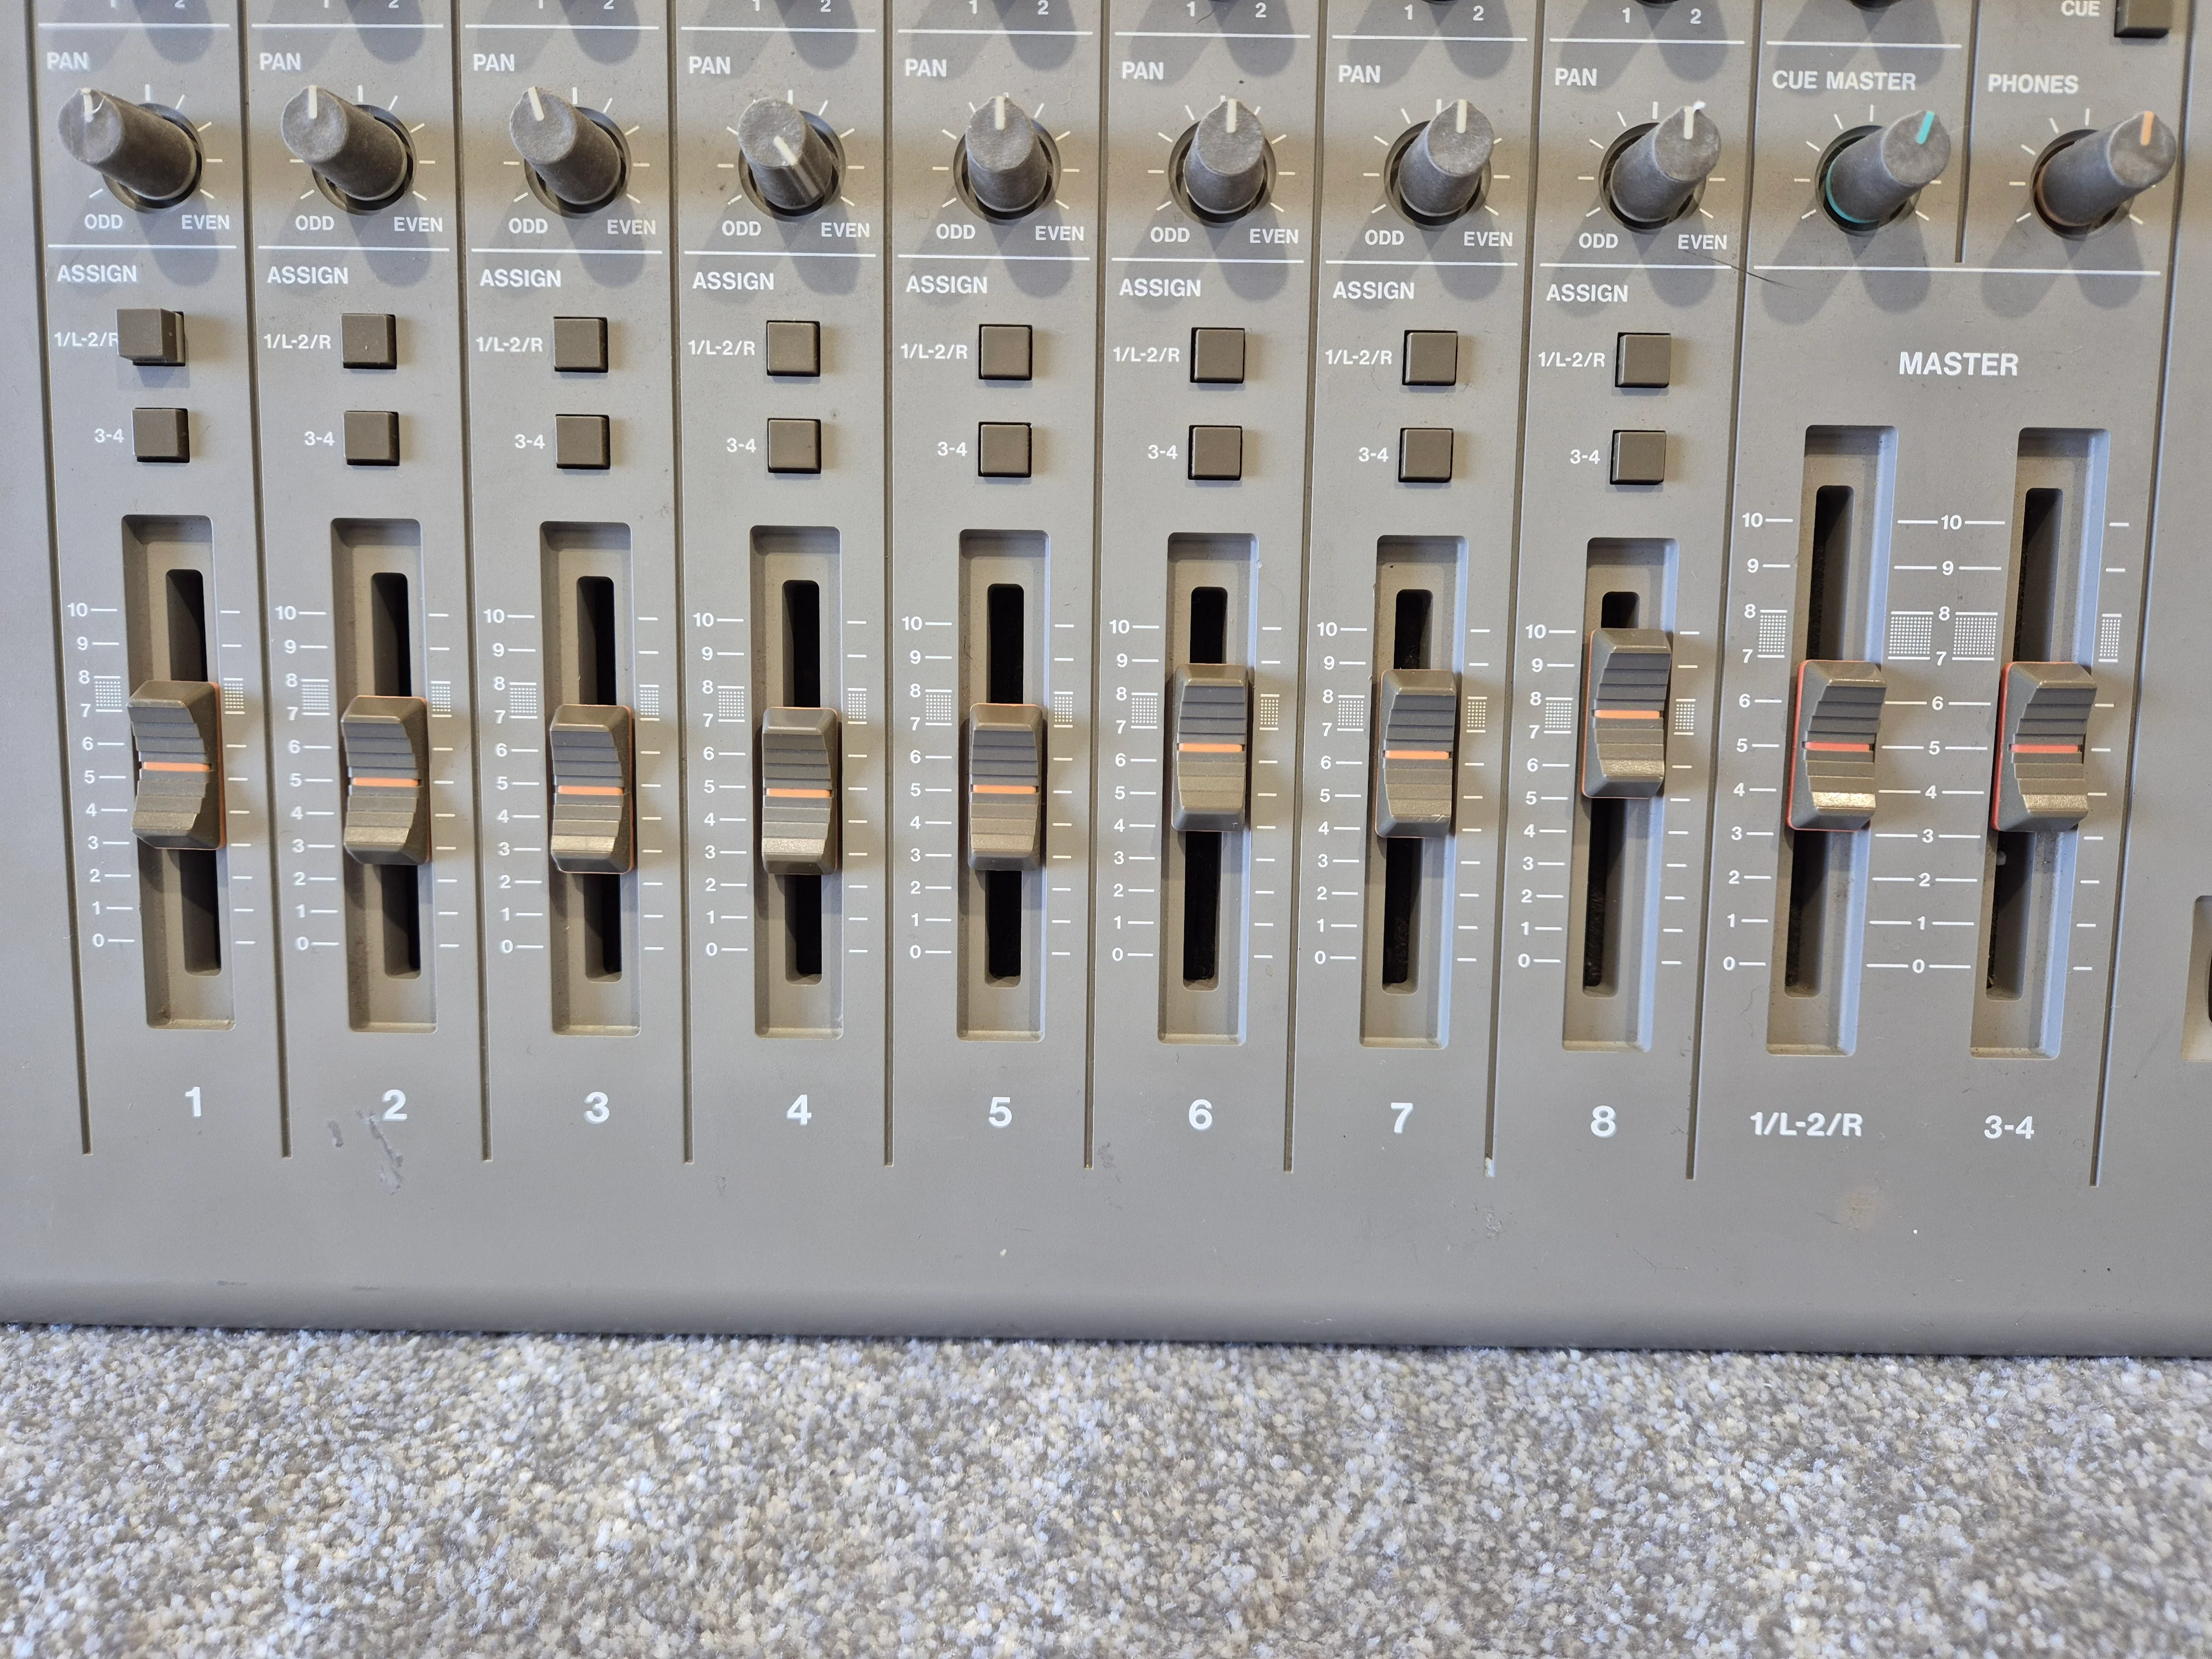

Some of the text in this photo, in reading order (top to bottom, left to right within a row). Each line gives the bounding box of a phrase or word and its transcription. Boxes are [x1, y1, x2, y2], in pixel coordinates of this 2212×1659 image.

[752, 0, 760, 12] 1
[820, 0, 832, 13] 2
[968, 0, 978, 14] 1
[1037, 0, 1049, 15] 2
[1186, 1, 1196, 17] 1
[1255, 2, 1267, 18] 2
[1404, 4, 1413, 20] 1
[1473, 5, 1484, 21] 2
[2060, 0, 2101, 17] CUE
[1622, 7, 1630, 23] 1
[1690, 8, 1702, 24] 2
[46, 51, 88, 70] PAN
[259, 52, 301, 71] PAN
[473, 53, 515, 72] PAN
[688, 56, 731, 75] PAN
[905, 58, 947, 77] PAN
[1122, 61, 1164, 80] PAN
[1338, 65, 1381, 84] PAN
[1554, 67, 1598, 86] PAN
[1772, 70, 1916, 91] CUE MASTER
[1988, 74, 2079, 94] PHONES
[84, 213, 123, 229] ODD
[181, 214, 230, 230] EVEN
[295, 215, 335, 231] ODD
[394, 216, 443, 232] EVEN
[508, 217, 549, 234] ODD
[607, 219, 656, 235] EVEN
[722, 220, 761, 236] ODD
[821, 222, 870, 238] EVEN
[936, 223, 976, 239] ODD
[1035, 225, 1084, 241] EVEN
[1150, 226, 1191, 243] ODD
[1249, 228, 1299, 244] EVEN
[1364, 229, 1405, 246] ODD
[1464, 231, 1513, 247] EVEN
[1578, 232, 1619, 249] ODD
[1678, 234, 1728, 251] EVEN
[56, 264, 137, 283] ASSIGN
[267, 265, 348, 285] ASSIGN
[479, 268, 561, 288] ASSIGN
[692, 271, 774, 291] ASSIGN
[905, 275, 988, 294] ASSIGN
[1119, 278, 1201, 297] ASSIGN
[1332, 280, 1415, 300] ASSIGN
[1546, 283, 1629, 302] ASSIGN
[263, 333, 331, 349] 1/L-2/R
[476, 336, 543, 352] 1/L-2/R
[688, 340, 755, 356] 1/L-2/R
[900, 343, 968, 359] 1/L-2/R
[1113, 346, 1180, 362] 1/L-2/R
[1324, 349, 1392, 365] 1/L-2/R
[1538, 351, 1605, 368] 1/L-2/R
[1899, 351, 2019, 376] MASTER
[95, 428, 124, 443] 3-4
[304, 431, 336, 446] 3-4
[514, 434, 546, 449] 3-4
[726, 437, 757, 453] 3-4
[937, 441, 968, 457] 3-4
[1147, 444, 1178, 460] 3-4
[1358, 447, 1389, 462] 3-4
[1569, 448, 1601, 465] 3-4
[1741, 512, 1764, 528] 10
[1940, 514, 1962, 530] 10
[1747, 558, 1759, 573] 9
[1942, 560, 1954, 576] 9
[67, 602, 88, 617] 10
[275, 606, 296, 620] 10
[483, 608, 505, 624] 10
[1744, 603, 1756, 619] 8
[1938, 606, 1950, 622] 8
[693, 612, 714, 627] 10
[901, 616, 922, 631] 10
[1109, 619, 1130, 634] 10
[1317, 622, 1338, 637] 10
[1525, 624, 1547, 639] 10
[1742, 648, 1754, 664] 7
[1936, 651, 1947, 666] 7
[79, 670, 90, 684] 8
[286, 673, 298, 687] 8
[493, 676, 505, 691] 8
[702, 680, 714, 695] 8
[909, 683, 921, 698] 8
[1115, 686, 1128, 701] 8
[1322, 688, 1334, 704] 8
[1530, 691, 1542, 706] 8
[1739, 693, 1751, 708] 6
[1932, 696, 1944, 711] 6
[80, 703, 91, 717] 7
[286, 706, 299, 721] 7
[494, 709, 506, 724] 7
[702, 713, 714, 728] 7
[910, 716, 921, 731] 7
[1115, 719, 1126, 734] 7
[1322, 722, 1333, 737] 7
[1528, 724, 1541, 739] 7
[1736, 738, 1748, 753] 5
[1928, 740, 1940, 755] 5
[84, 770, 95, 784] 5
[290, 773, 302, 787] 5
[497, 776, 509, 790] 5
[703, 779, 715, 794] 5
[910, 782, 921, 797] 5
[1114, 785, 1125, 800] 5
[1733, 782, 1745, 797] 4
[1924, 785, 1937, 799] 4
[1319, 788, 1331, 803] 5
[1525, 791, 1537, 805] 5
[1731, 826, 1743, 841] 3
[1922, 828, 1934, 843] 3
[87, 836, 99, 850] 3
[293, 838, 305, 853] 3
[498, 842, 510, 856] 3
[705, 844, 716, 859] 3
[910, 847, 921, 862] 3
[1114, 851, 1124, 865] 3
[1317, 853, 1328, 868] 3
[1522, 856, 1534, 870] 3
[1728, 869, 1740, 884] 2
[1918, 872, 1931, 887] 2
[92, 901, 100, 915] 1
[706, 910, 714, 924] 1
[911, 912, 919, 927] 1
[1114, 915, 1121, 930] 1
[1727, 913, 1735, 928] 1
[1917, 916, 1926, 931] 1
[1317, 918, 1324, 932] 1
[1520, 921, 1530, 936] 1
[92, 933, 105, 948] 0
[296, 936, 309, 951] 0
[500, 939, 514, 954] 0
[706, 942, 718, 956] 0
[910, 945, 921, 959] 0
[1112, 947, 1124, 962] 0
[1314, 950, 1326, 964] 0
[1518, 953, 1531, 968] 0
[1723, 956, 1736, 971] 0
[1912, 958, 1925, 974] 0
[185, 1086, 202, 1118] 1
[382, 1089, 408, 1121] 2
[584, 1091, 610, 1124] 3
[786, 1094, 812, 1126] 4
[988, 1096, 1013, 1129] 5
[1188, 1099, 1213, 1130] 6
[1390, 1102, 1413, 1134] 7
[1590, 1105, 1616, 1138] 8
[1750, 1112, 1863, 1137] 1/L-2/R
[1984, 1115, 2034, 1140] 3-4
